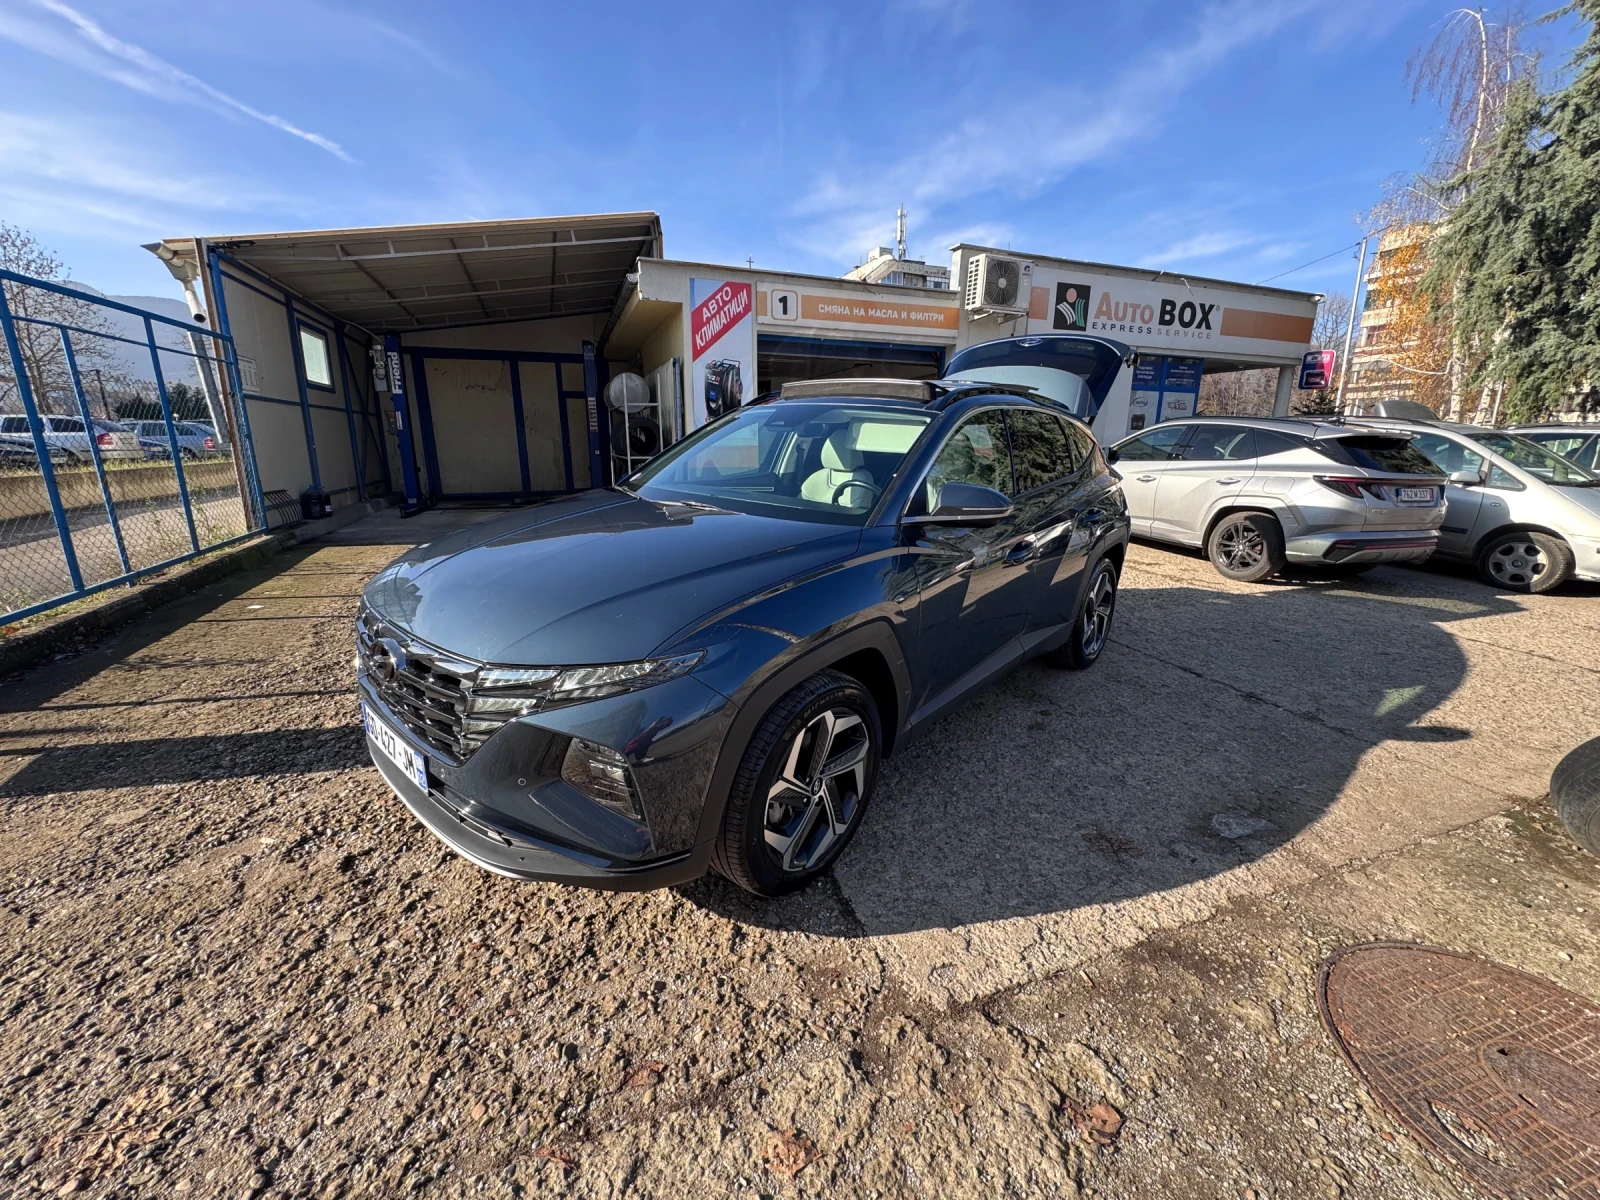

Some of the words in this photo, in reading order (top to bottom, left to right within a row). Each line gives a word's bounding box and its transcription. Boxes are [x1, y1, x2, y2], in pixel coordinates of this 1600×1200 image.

[695, 288, 748, 350] КЛИМАТИЦИ
[702, 286, 732, 322] АВТО
[777, 295, 788, 316] 1
[818, 304, 850, 315] СМЯНА
[853, 307, 865, 316] НА
[868, 308, 898, 318] МАСЛА
[901, 311, 908, 319] И
[909, 311, 944, 322] ФИЛТРИ
[1158, 299, 1215, 330] BOX
[1092, 322, 1152, 335] EXPRESS
[1157, 328, 1212, 339] SERVICE
[387, 352, 403, 395] Friend
